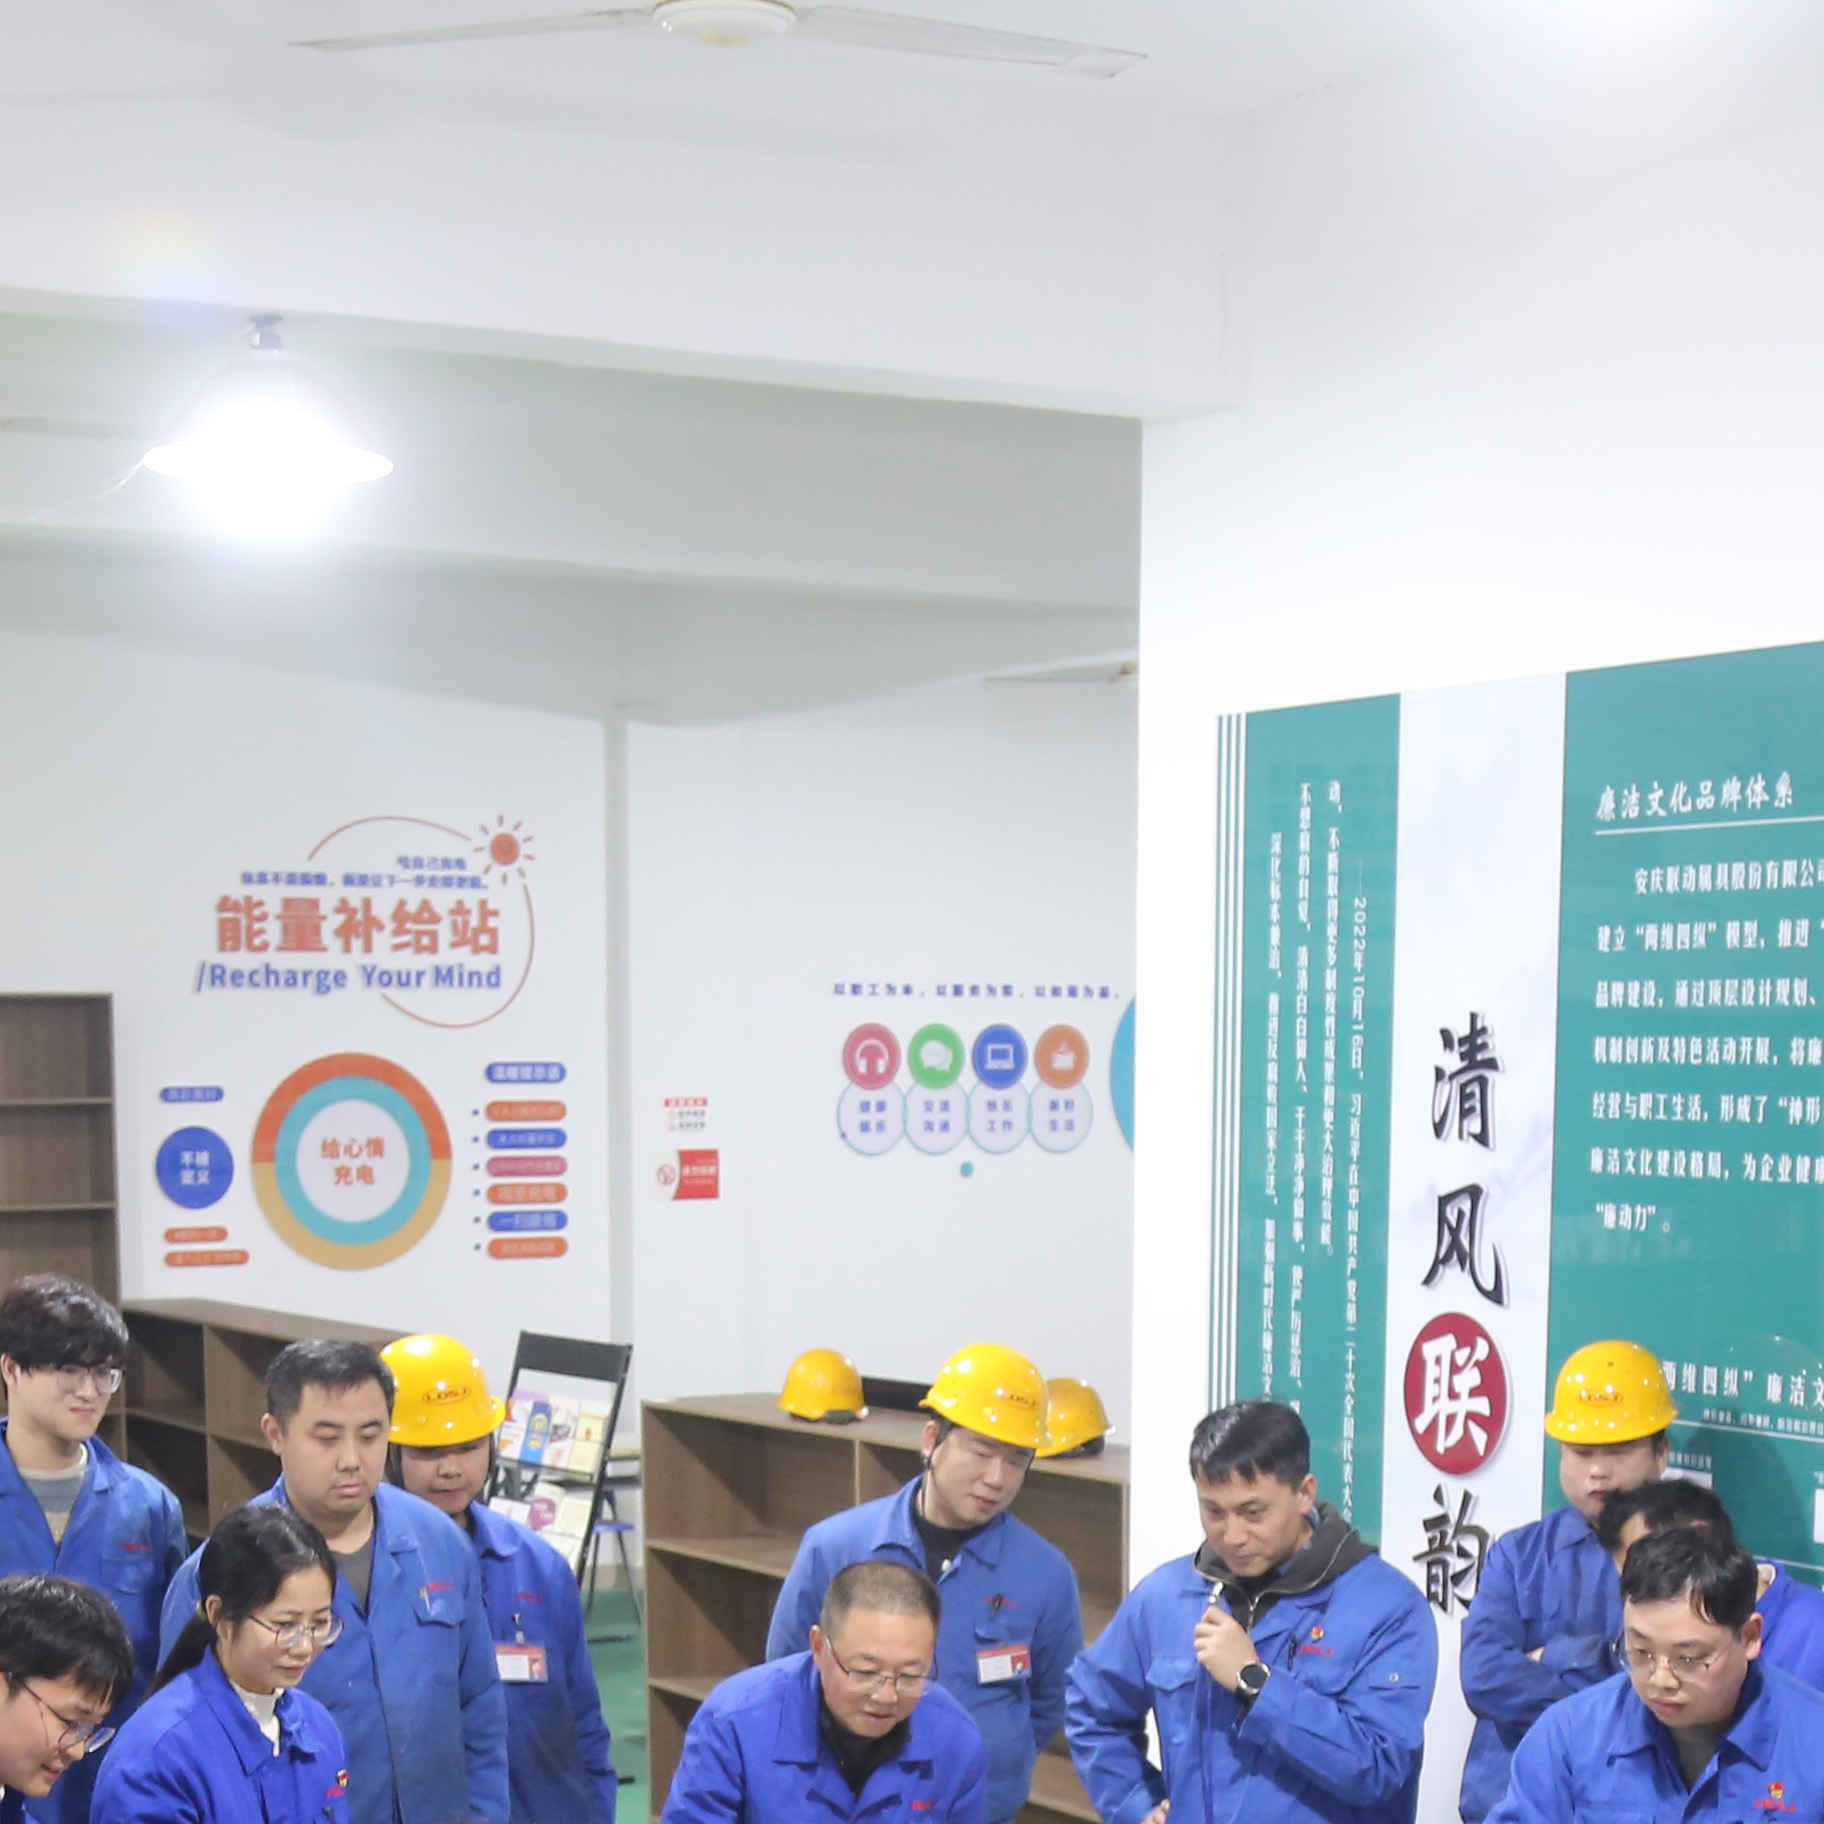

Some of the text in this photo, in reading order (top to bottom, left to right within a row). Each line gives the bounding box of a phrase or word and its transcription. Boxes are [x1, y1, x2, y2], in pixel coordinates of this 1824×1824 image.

[1596, 771, 1793, 821] 廉洁文化品牌体系
[215, 895, 502, 956] 能量补给站
[362, 963, 428, 989] Your
[432, 963, 502, 990] Mind
[924, 1100, 950, 1113] 交流
[987, 1100, 1013, 1113] 快乐
[1049, 1100, 1075, 1112] 美好
[924, 1120, 950, 1133] 沟通
[987, 1120, 1013, 1132] 工作
[1049, 1120, 1075, 1132] 生活
[320, 1137, 385, 1161] 给心情
[181, 1169, 210, 1186] 定义
[333, 1163, 375, 1186] 充电
[1596, 1202, 1671, 1233] “廉动力”。
[1413, 1012, 1507, 1614] 清风联韵
